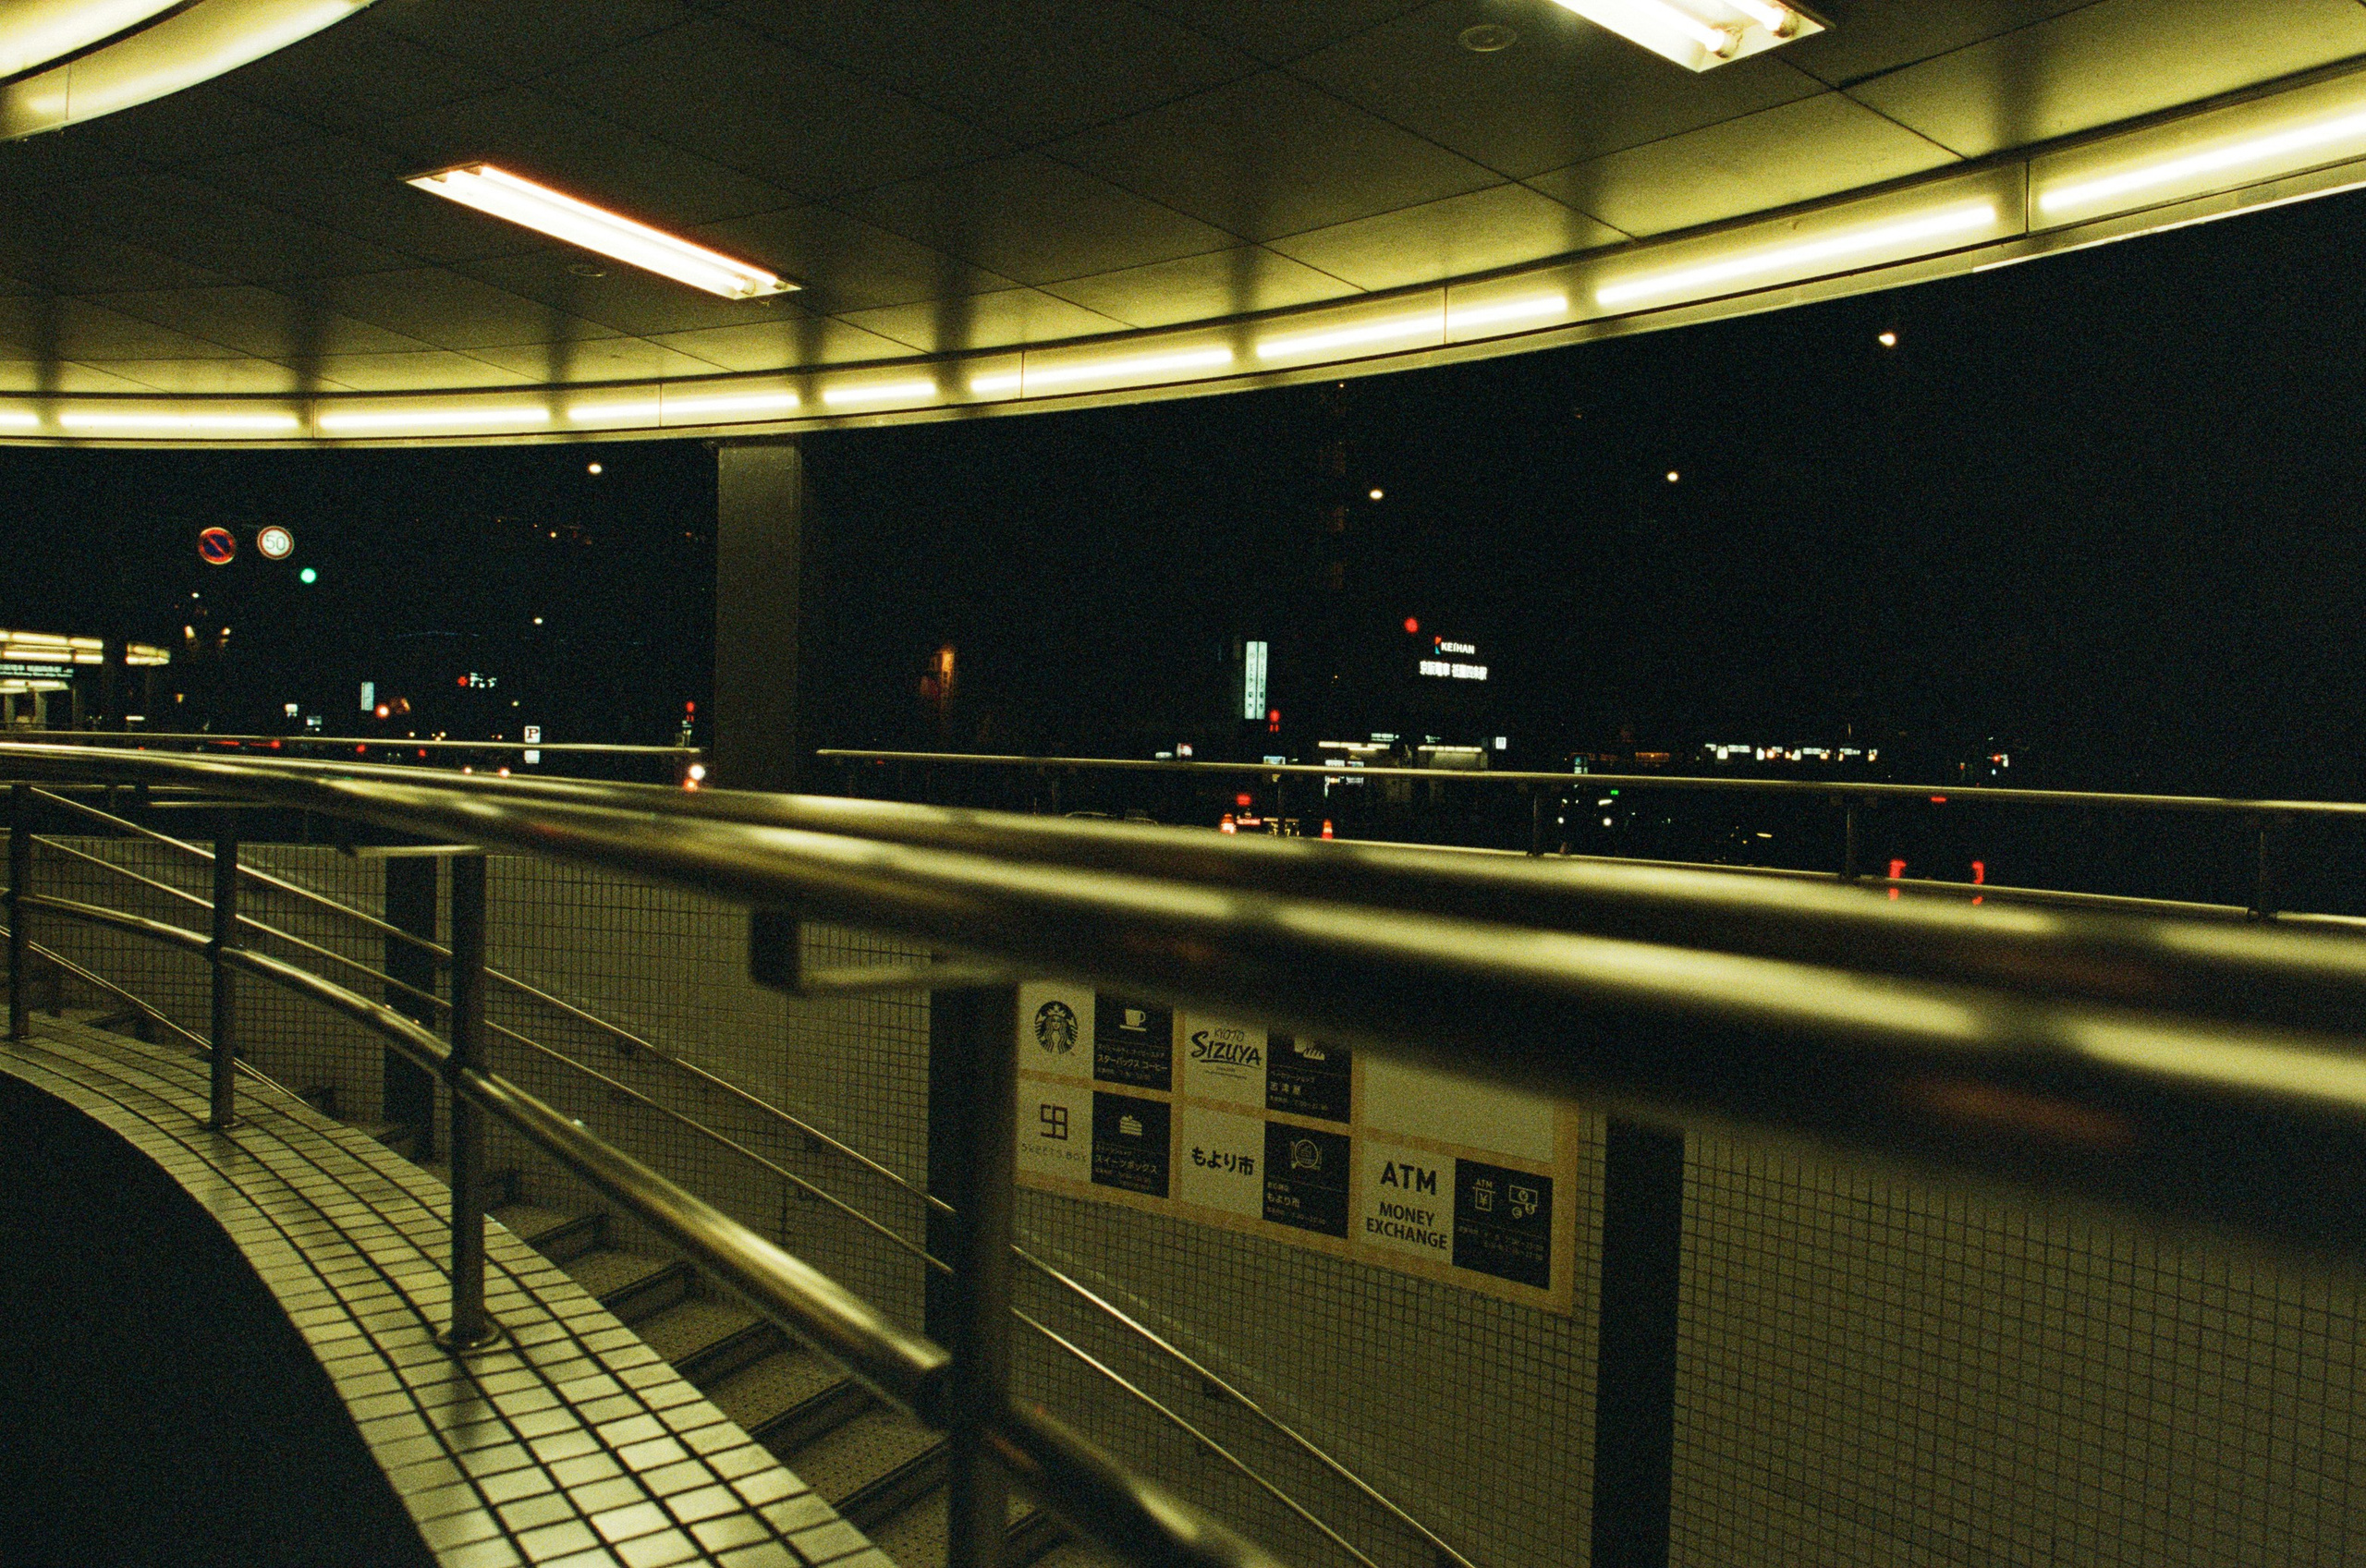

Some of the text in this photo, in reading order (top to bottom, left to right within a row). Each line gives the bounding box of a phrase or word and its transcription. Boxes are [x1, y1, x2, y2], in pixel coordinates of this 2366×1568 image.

[265, 534, 287, 552] 50
[1441, 641, 1476, 655] KEIHAN
[527, 727, 539, 739] P
[1214, 1027, 1245, 1042] KYOTO
[1190, 1030, 1262, 1066] SIZUYA
[1191, 1146, 1255, 1176] もより市
[1380, 1161, 1437, 1196] ATM
[1475, 1178, 1493, 1188] ATM
[1379, 1201, 1435, 1227] MONEY
[1366, 1217, 1448, 1250] EXCHANGE
